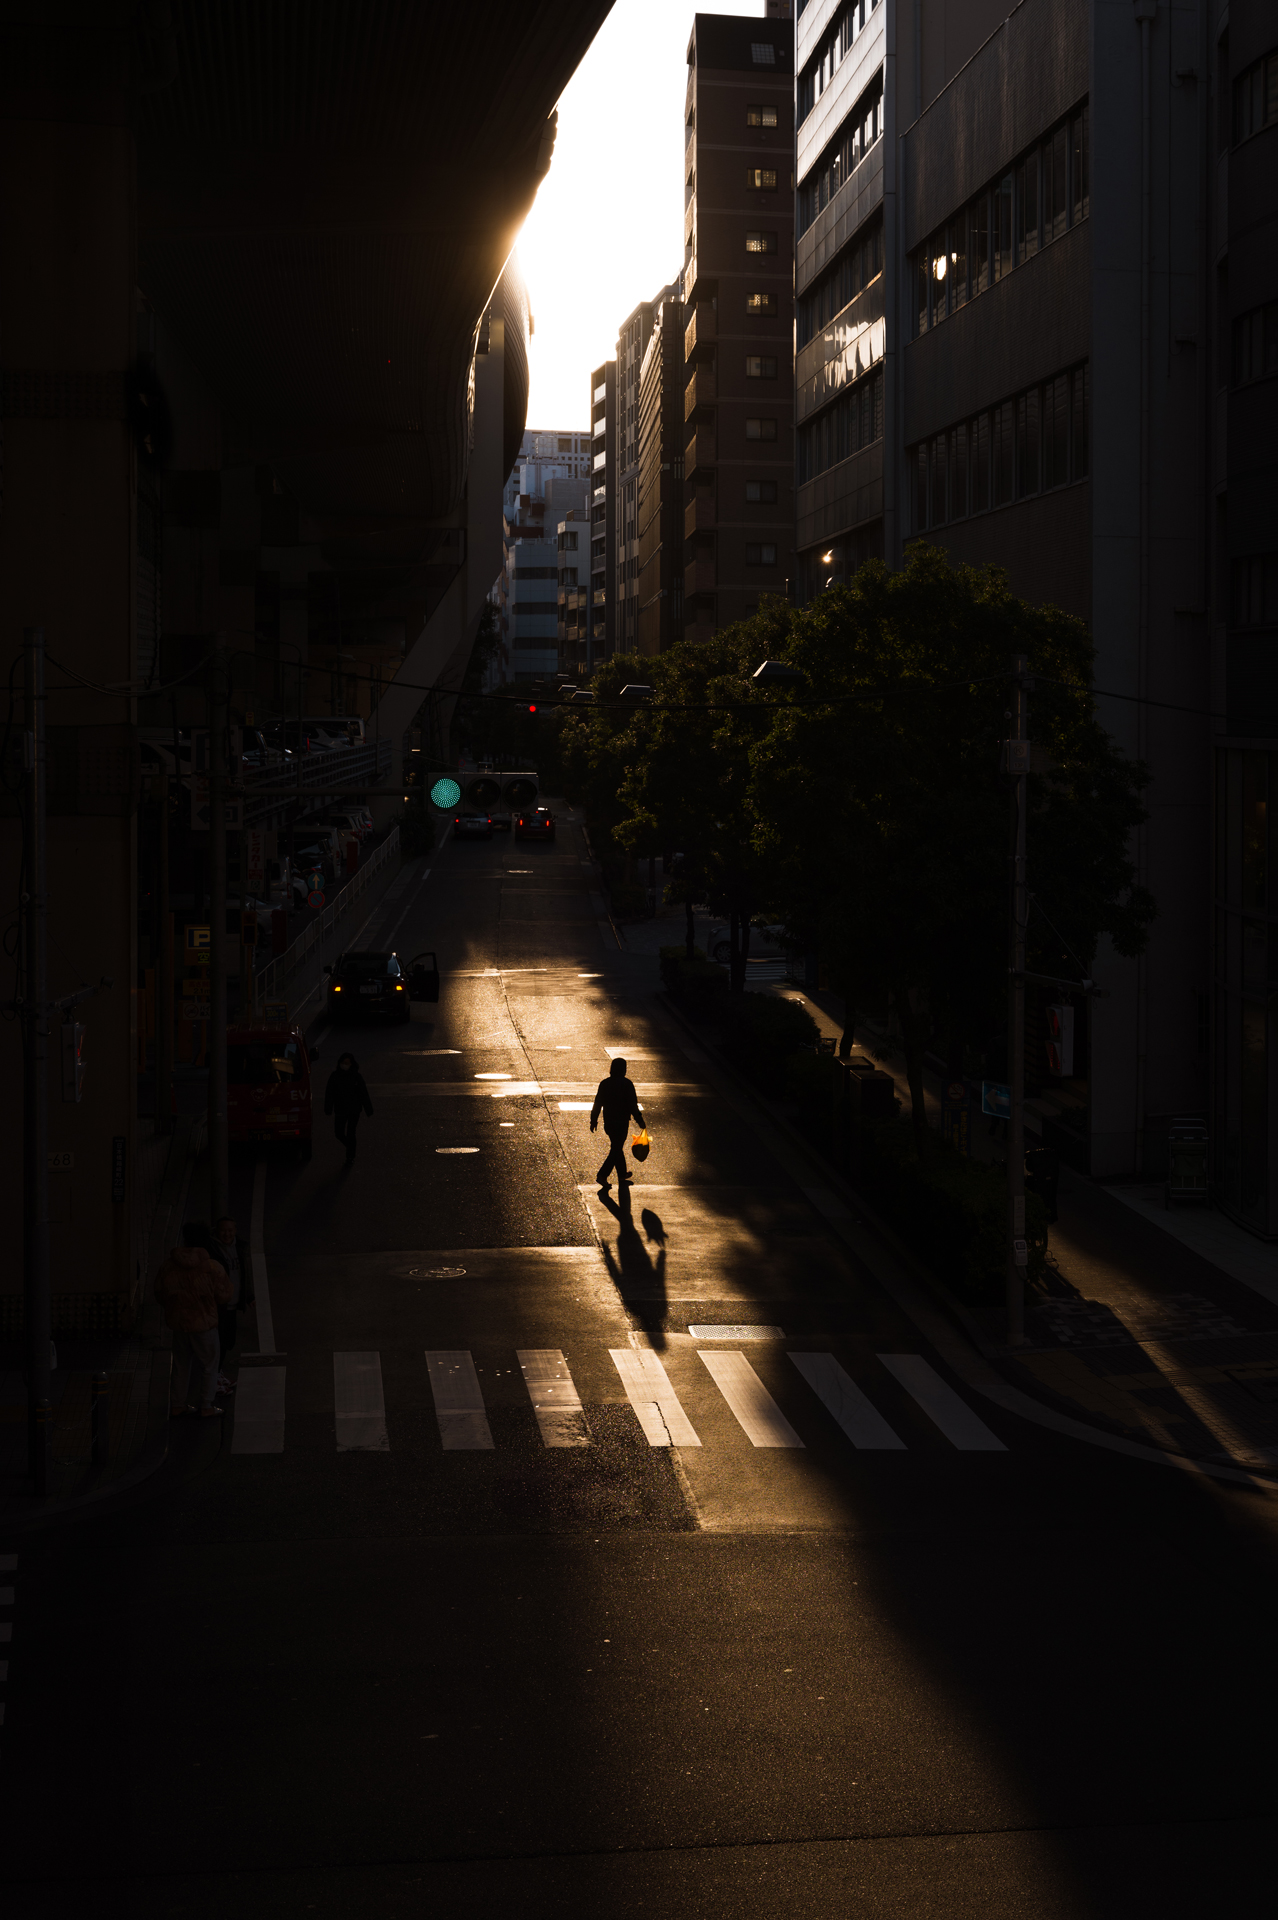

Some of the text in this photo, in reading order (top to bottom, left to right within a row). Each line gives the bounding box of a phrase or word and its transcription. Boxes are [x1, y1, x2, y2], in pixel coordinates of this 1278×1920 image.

[251, 832, 261, 868] レンタカー
[193, 930, 210, 947] P
[197, 951, 210, 964] 空
[290, 1089, 308, 1101] EV
[114, 1178, 123, 1186] 22
